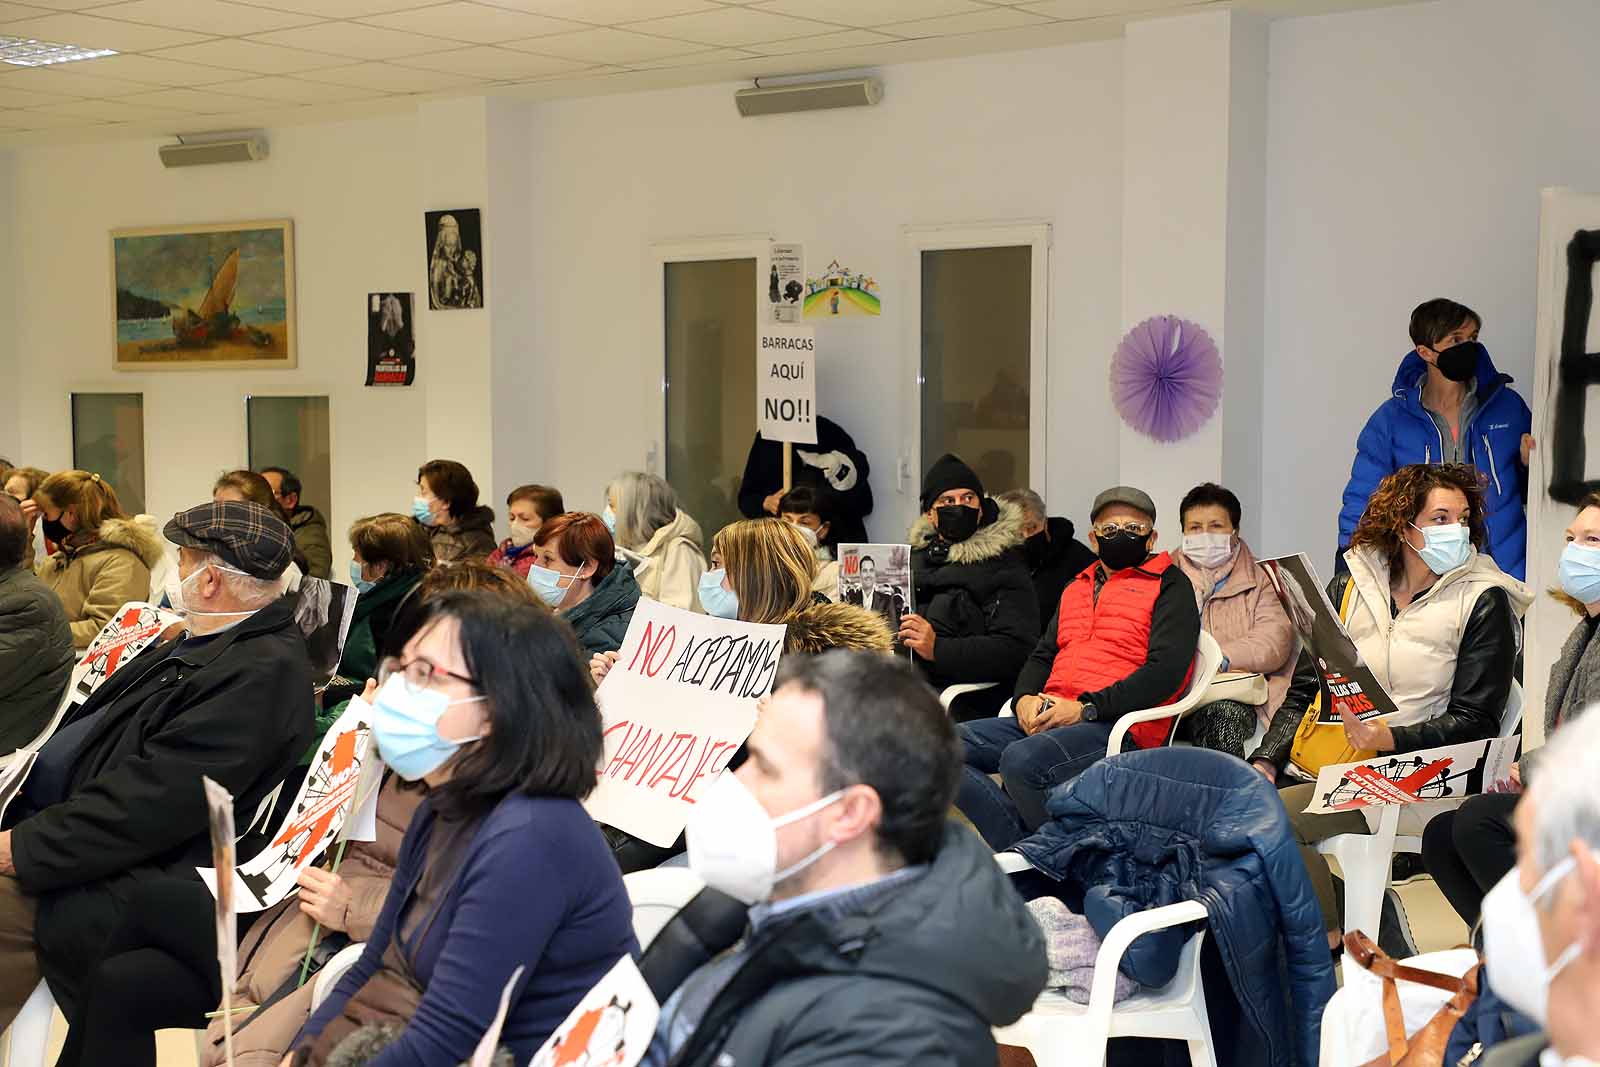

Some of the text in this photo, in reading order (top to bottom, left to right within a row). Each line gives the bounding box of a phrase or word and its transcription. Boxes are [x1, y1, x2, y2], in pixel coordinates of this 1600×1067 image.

[762, 336, 814, 351] BARRACAS
[770, 361, 805, 379] AQUÍ
[764, 397, 810, 423] NO!!
[628, 620, 781, 698] NO ACEPTAMOS
